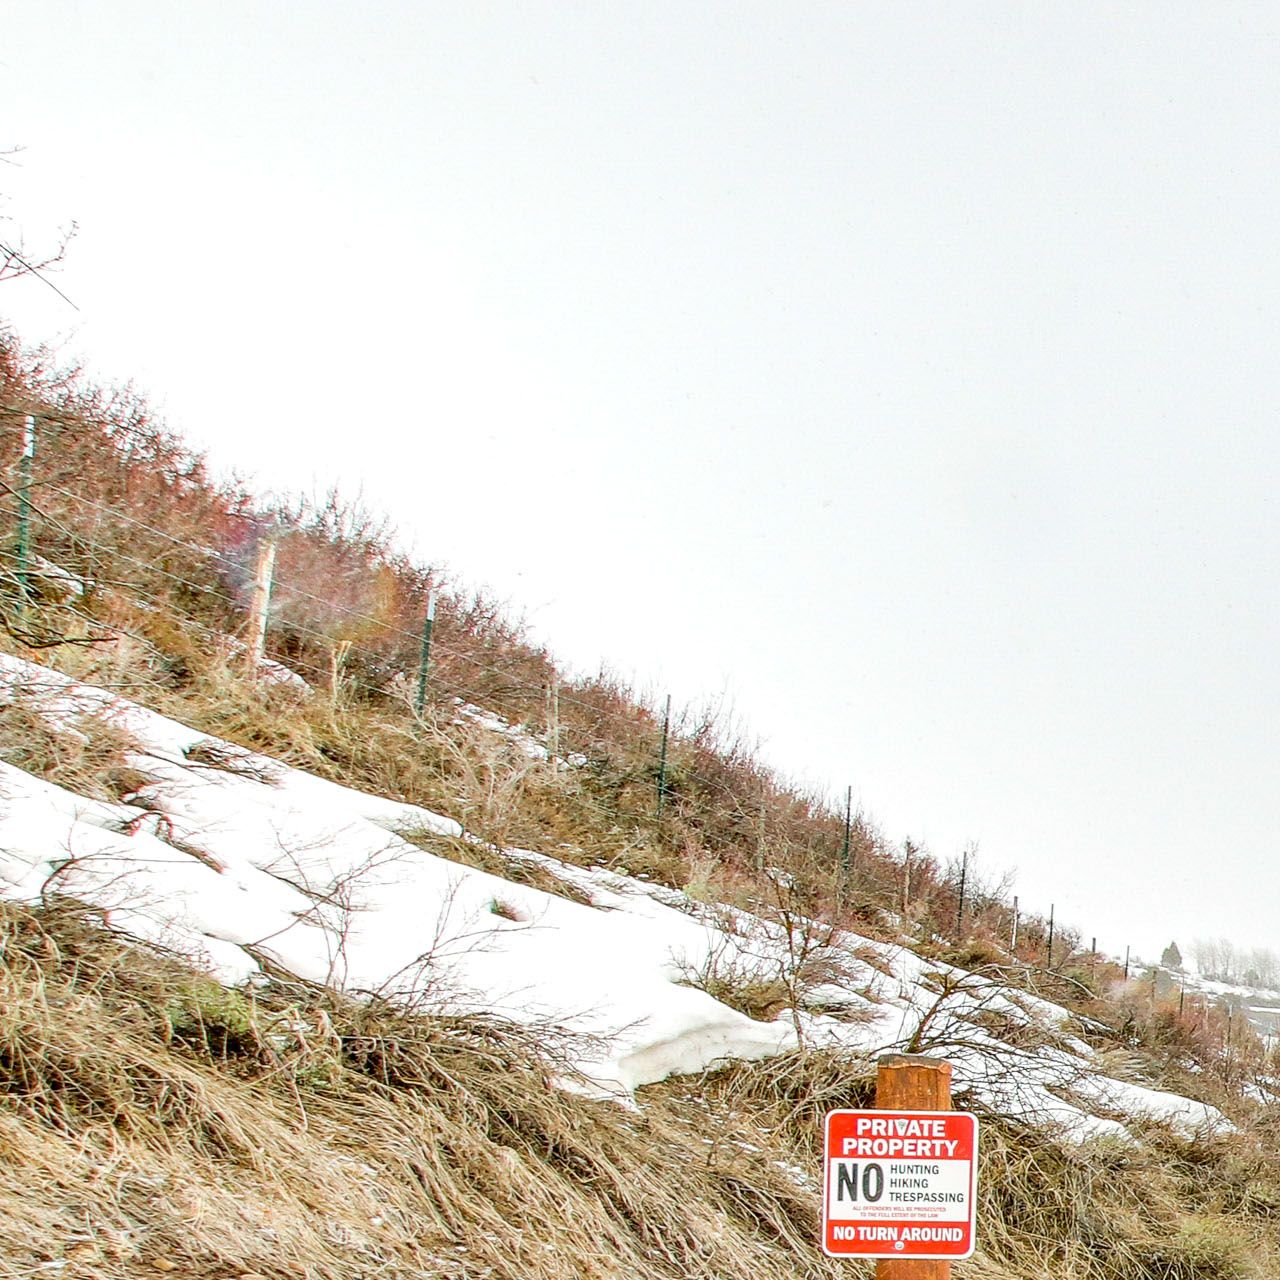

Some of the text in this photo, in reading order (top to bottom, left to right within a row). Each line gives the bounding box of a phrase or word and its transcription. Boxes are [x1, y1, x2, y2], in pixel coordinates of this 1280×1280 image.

[857, 1118, 946, 1137] PRIVATE
[843, 1138, 959, 1157] PROPERTY
[890, 1164, 939, 1175] HUNTING
[837, 1163, 884, 1202] NO
[890, 1178, 929, 1188] HIKING
[889, 1192, 964, 1203] TRESPASSING
[834, 1226, 963, 1242] NO TURN AROUND
